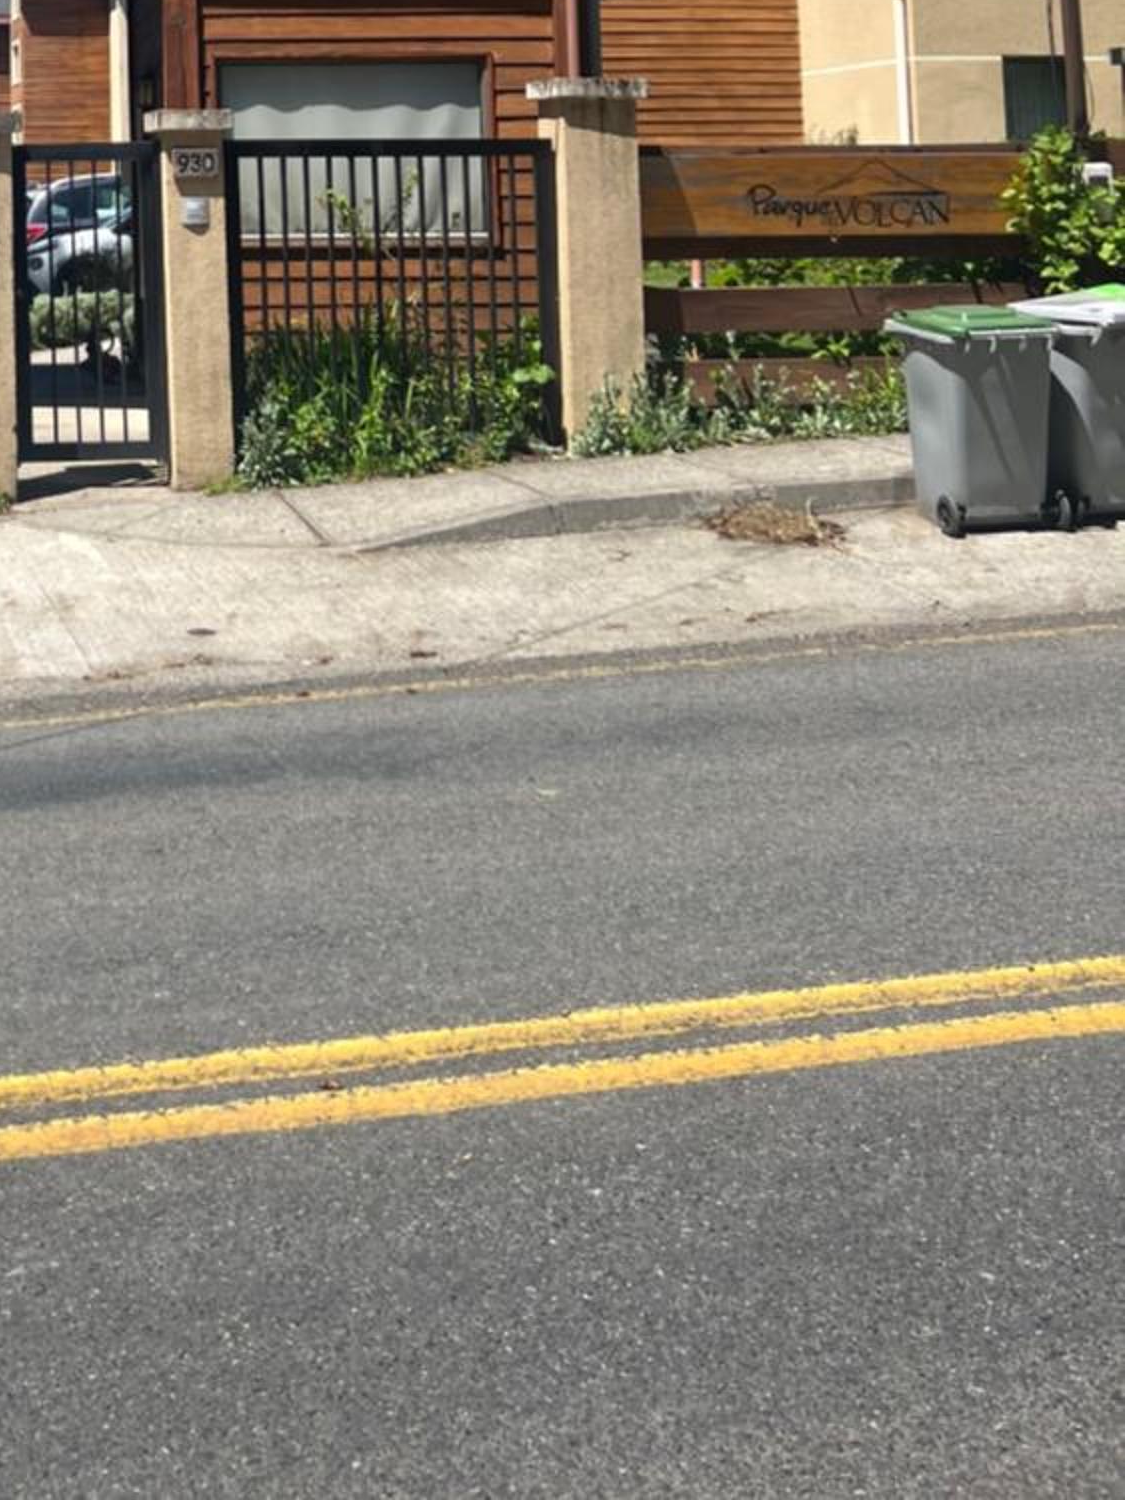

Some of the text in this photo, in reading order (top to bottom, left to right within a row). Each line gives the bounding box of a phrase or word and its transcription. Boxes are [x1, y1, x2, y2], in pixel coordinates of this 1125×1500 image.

[178, 153, 216, 173] 930
[747, 184, 951, 229] Parque VOLCAN
